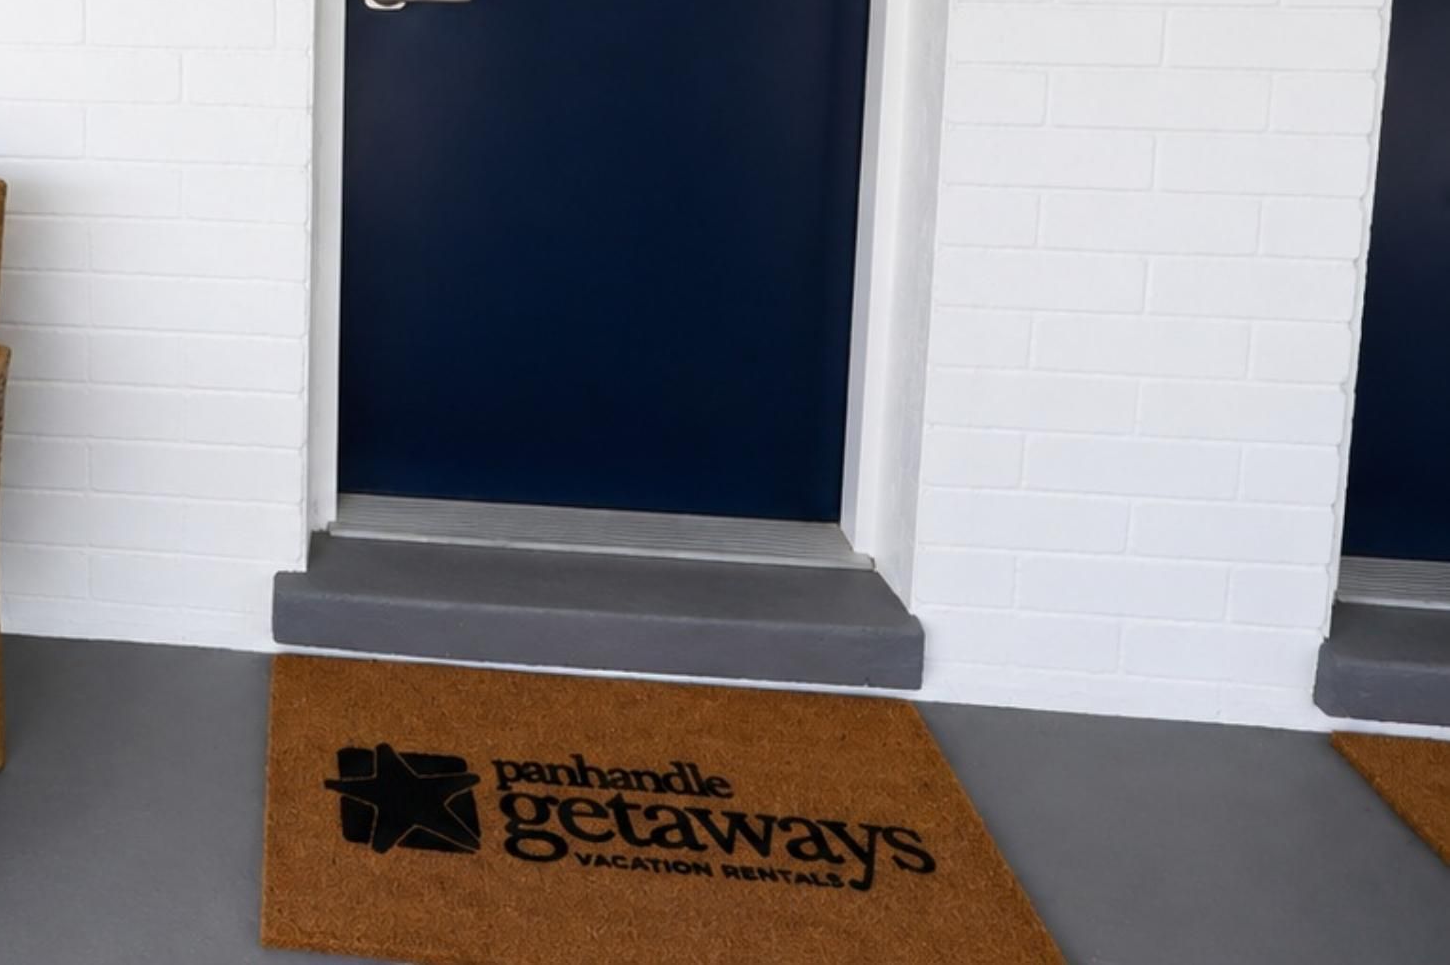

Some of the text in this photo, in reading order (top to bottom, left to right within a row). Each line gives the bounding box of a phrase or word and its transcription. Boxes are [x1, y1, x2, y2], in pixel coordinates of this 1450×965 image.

[492, 753, 734, 800] panhandle
[498, 789, 938, 893] getaways
[572, 851, 844, 889] VACATION RENTALS
